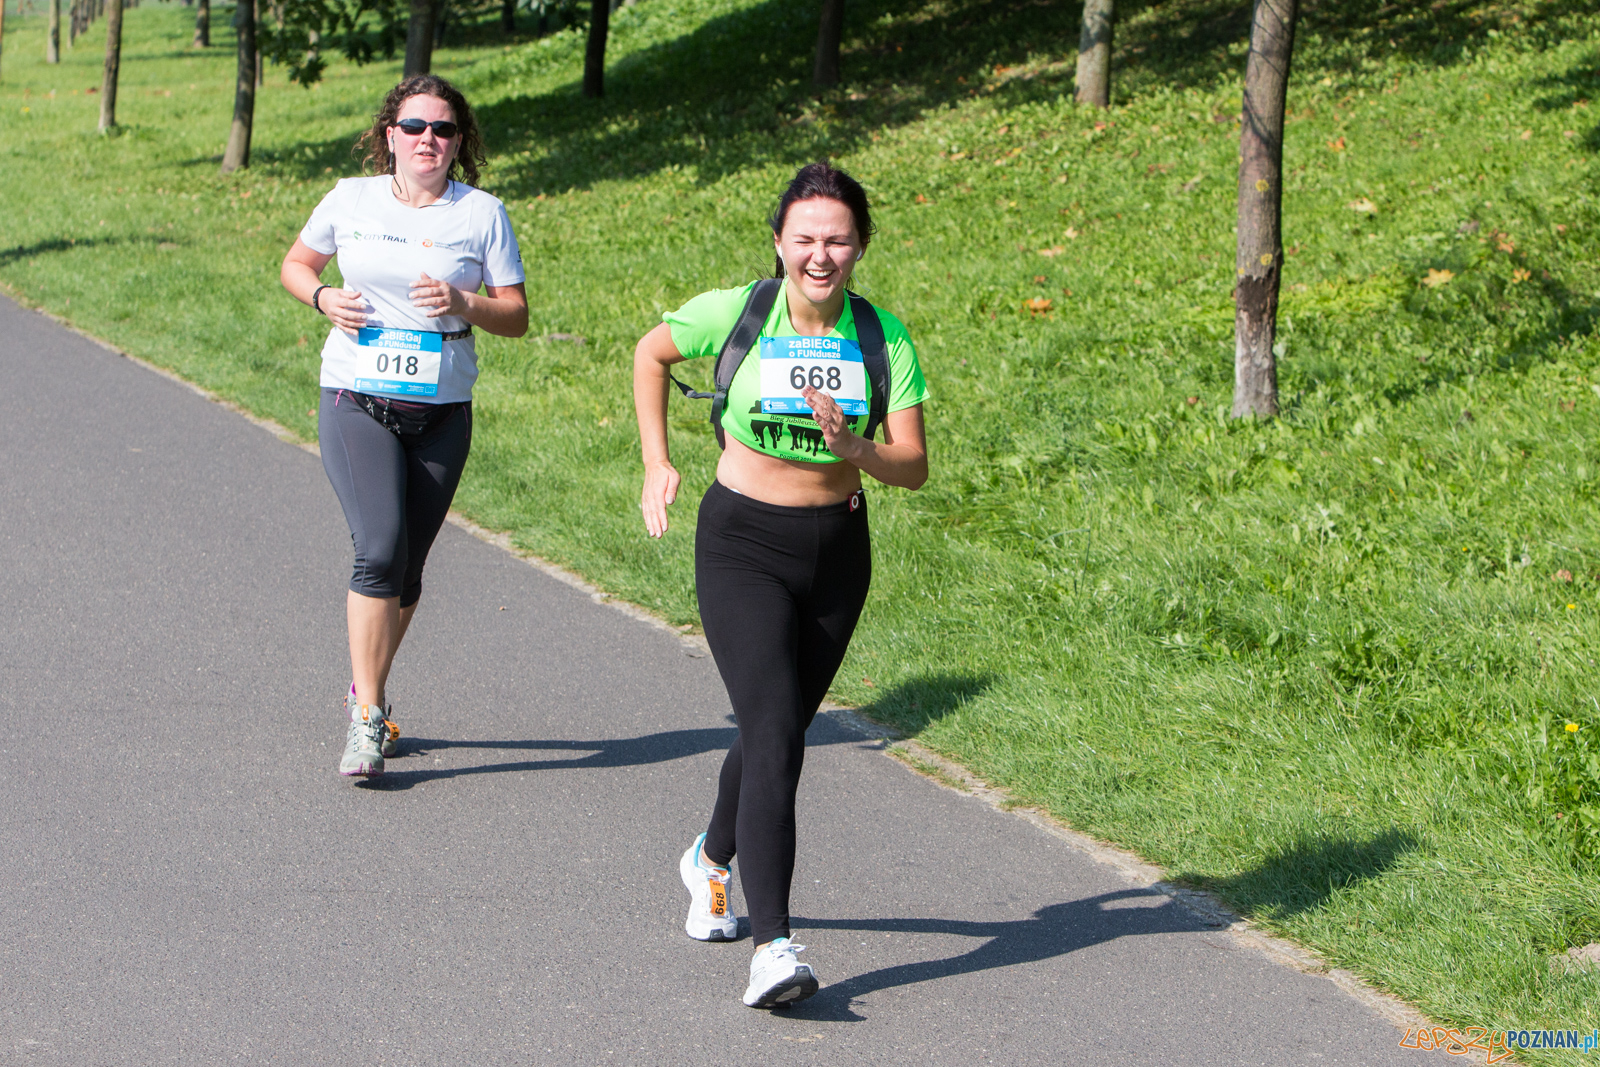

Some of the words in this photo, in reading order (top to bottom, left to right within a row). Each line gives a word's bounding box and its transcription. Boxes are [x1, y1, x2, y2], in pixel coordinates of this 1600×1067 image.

[379, 331, 422, 344] zaBIEGaj
[384, 341, 421, 350] FUNdusze
[788, 338, 841, 352] zaBIEGaj
[797, 349, 841, 359] FUNdusze
[376, 353, 419, 376] 018
[790, 365, 842, 391] 668
[785, 417, 819, 427] Jubileuszo
[715, 892, 725, 915] 668
